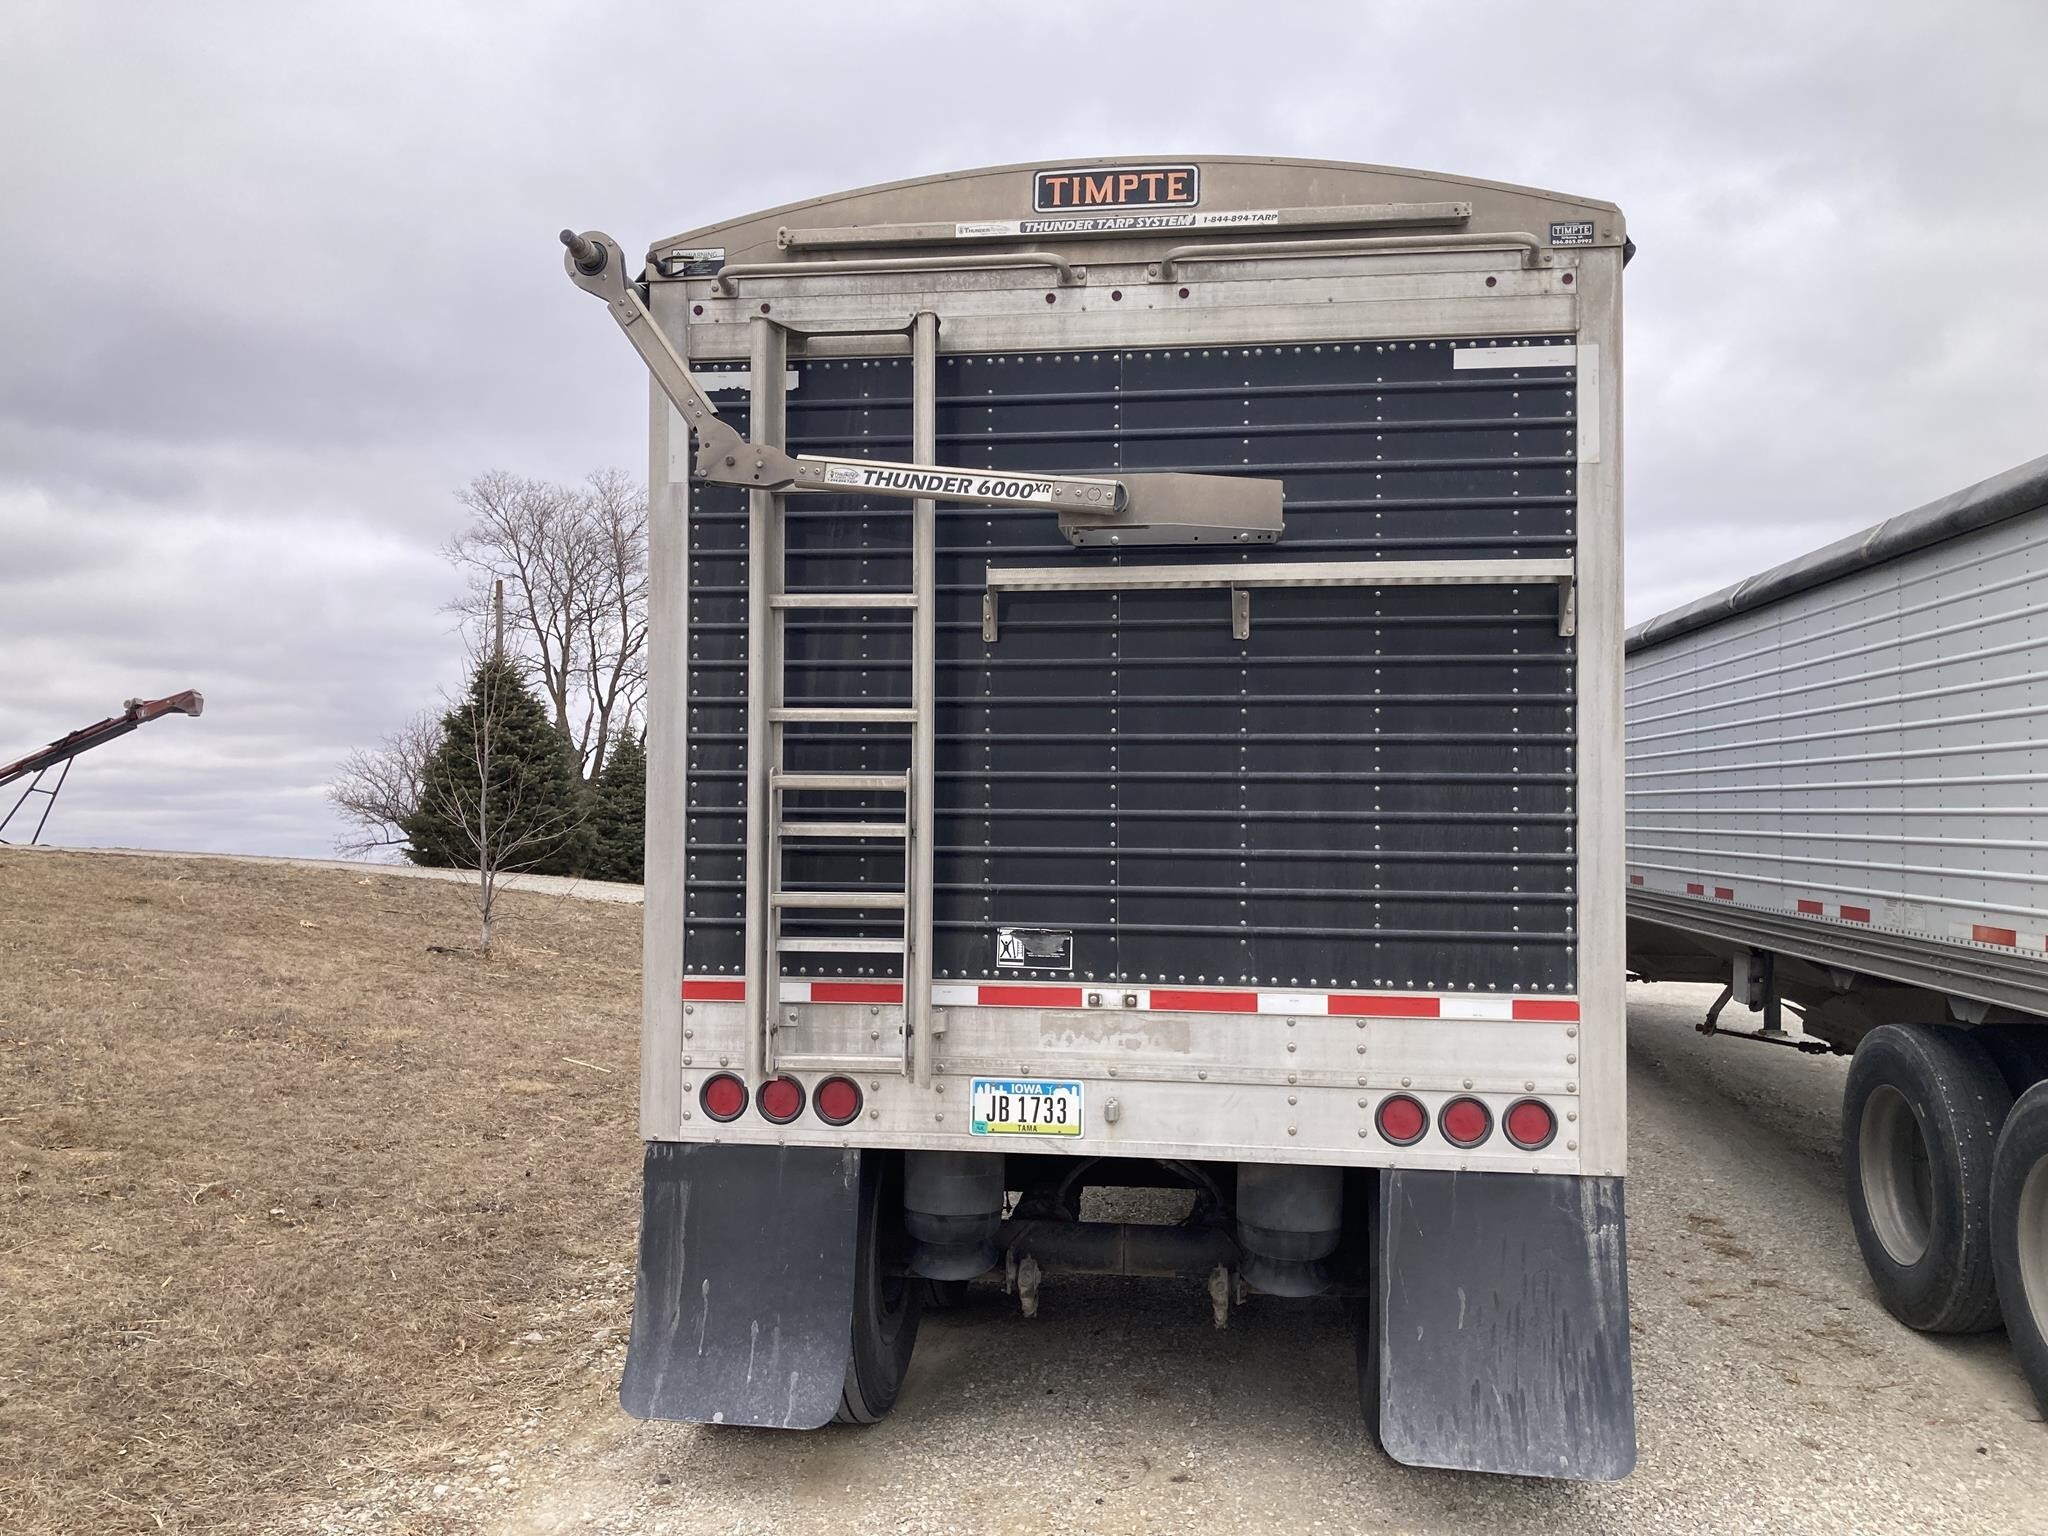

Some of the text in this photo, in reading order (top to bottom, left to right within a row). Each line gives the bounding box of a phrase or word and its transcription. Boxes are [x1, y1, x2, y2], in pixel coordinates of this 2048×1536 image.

[1045, 172, 1188, 206] TIMPTE
[1025, 215, 1192, 233] THUNDER TARP SYSTEM
[1203, 214, 1278, 224] 1-844-894-TARP
[1555, 226, 1590, 235] TIMPTE
[863, 469, 973, 494] THUNDER
[1011, 1083, 1043, 1094] IOWA
[986, 1095, 1067, 1124] JB 1733
[1017, 1124, 1038, 1132] TAMA
